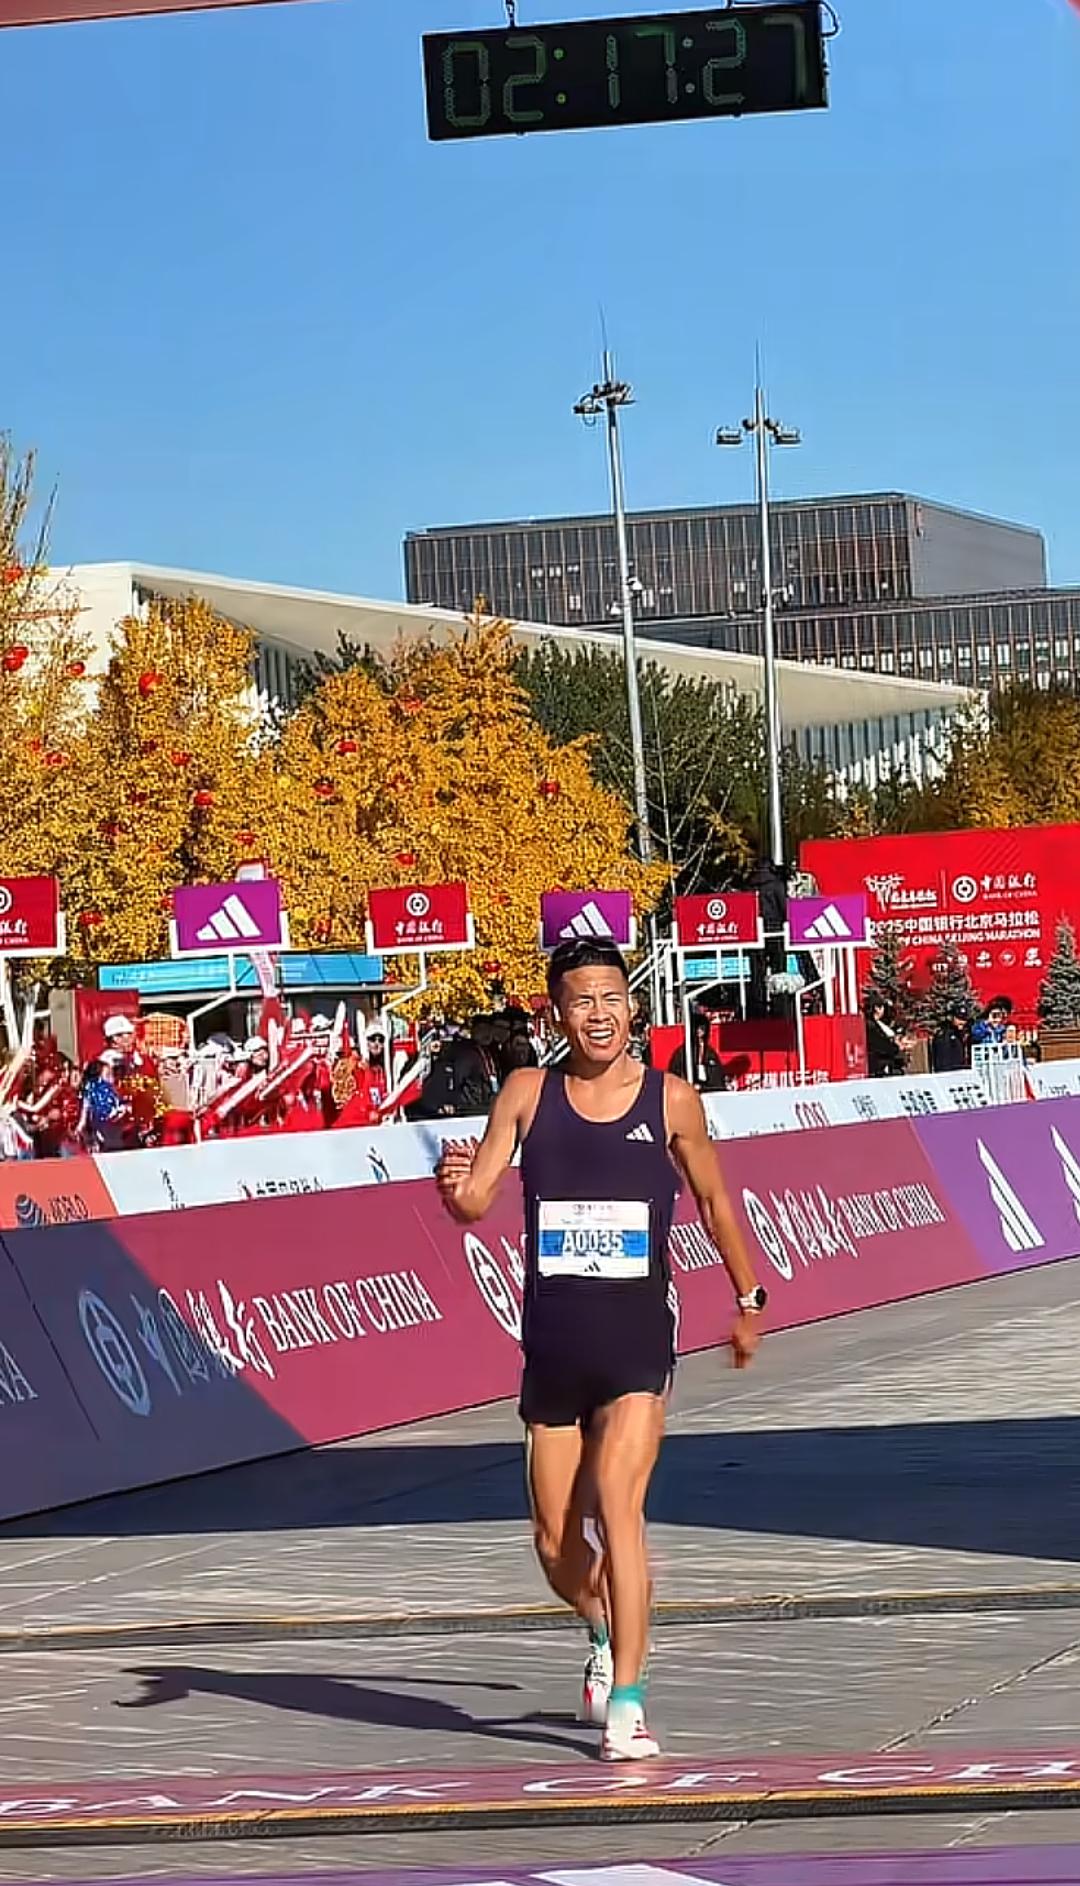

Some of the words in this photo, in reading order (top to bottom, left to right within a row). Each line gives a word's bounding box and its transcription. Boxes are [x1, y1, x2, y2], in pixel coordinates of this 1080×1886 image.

[443, 15, 808, 127] 02:17:27
[562, 1229, 625, 1256] A0035
[252, 1287, 338, 1352] BANK
[323, 1281, 367, 1339] OF
[355, 1269, 444, 1333] CHINA
[523, 1772, 760, 1793] OF
